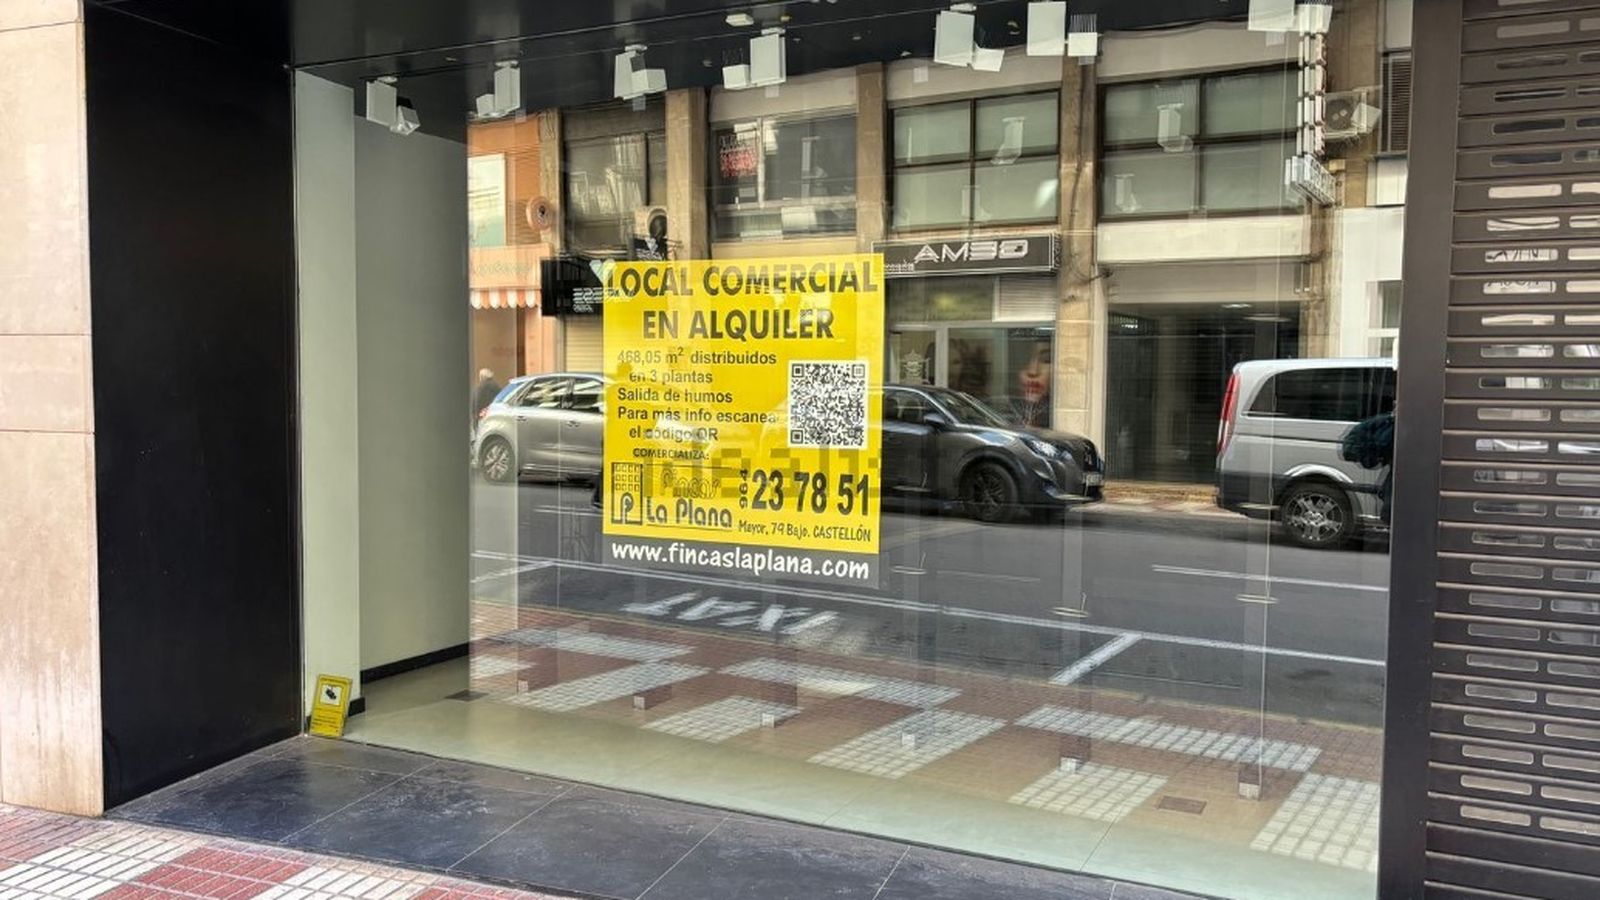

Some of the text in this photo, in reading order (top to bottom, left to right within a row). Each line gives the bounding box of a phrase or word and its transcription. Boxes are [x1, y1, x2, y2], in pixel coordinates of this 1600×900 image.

[608, 265, 694, 297] LOCAL
[702, 261, 878, 296] COMERCIAL
[643, 309, 835, 342] EN ALQUILER
[617, 350, 661, 366] 468,05
[690, 351, 777, 365] distribuidos
[629, 370, 713, 385] en 3 plantas
[617, 387, 733, 403] Salida de humos
[617, 406, 777, 424] Para más info escanea
[629, 425, 719, 443] el código QR
[632, 447, 710, 460] COMERCIALIZA:
[739, 468, 749, 509] 964
[751, 469, 869, 516] 23 78 51
[646, 496, 733, 528] La Plana
[771, 522, 785, 536] 79
[813, 524, 871, 542] CASTELLÓN
[611, 542, 870, 580] www.fincaslaplana.com
